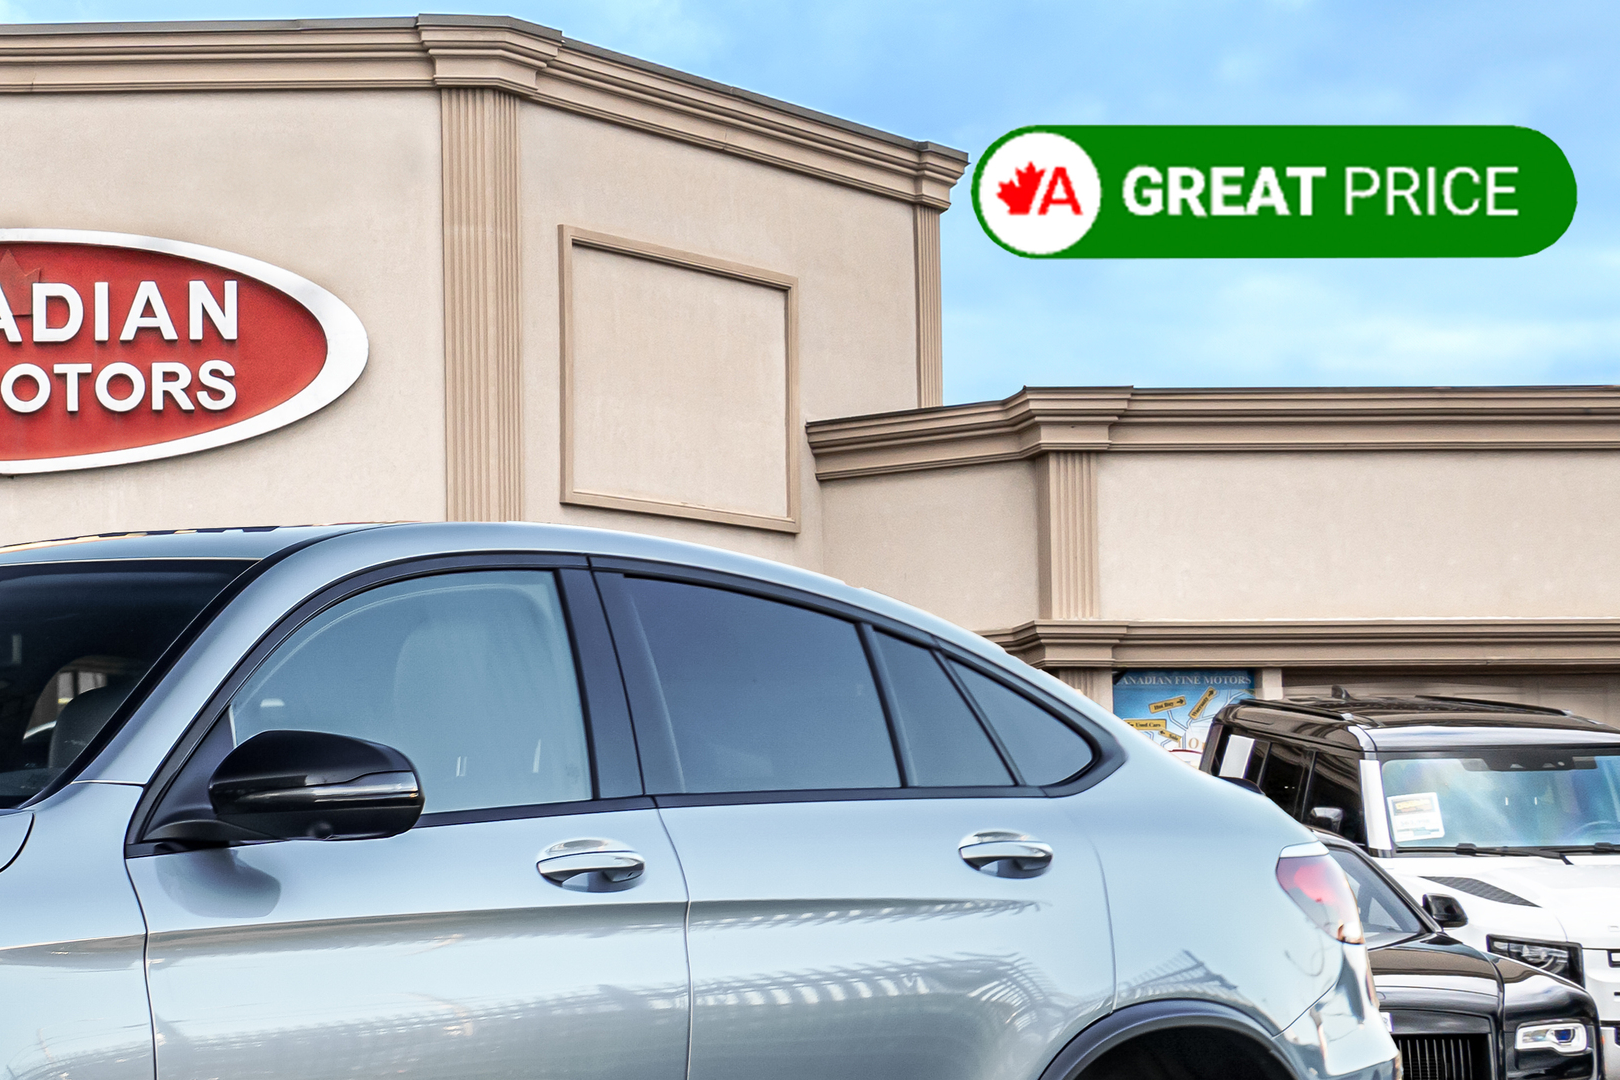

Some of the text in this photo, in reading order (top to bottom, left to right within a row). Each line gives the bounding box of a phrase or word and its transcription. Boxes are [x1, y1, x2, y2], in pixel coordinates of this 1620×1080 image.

[1121, 675, 1252, 685] ANADIAN FINE MOTORS
